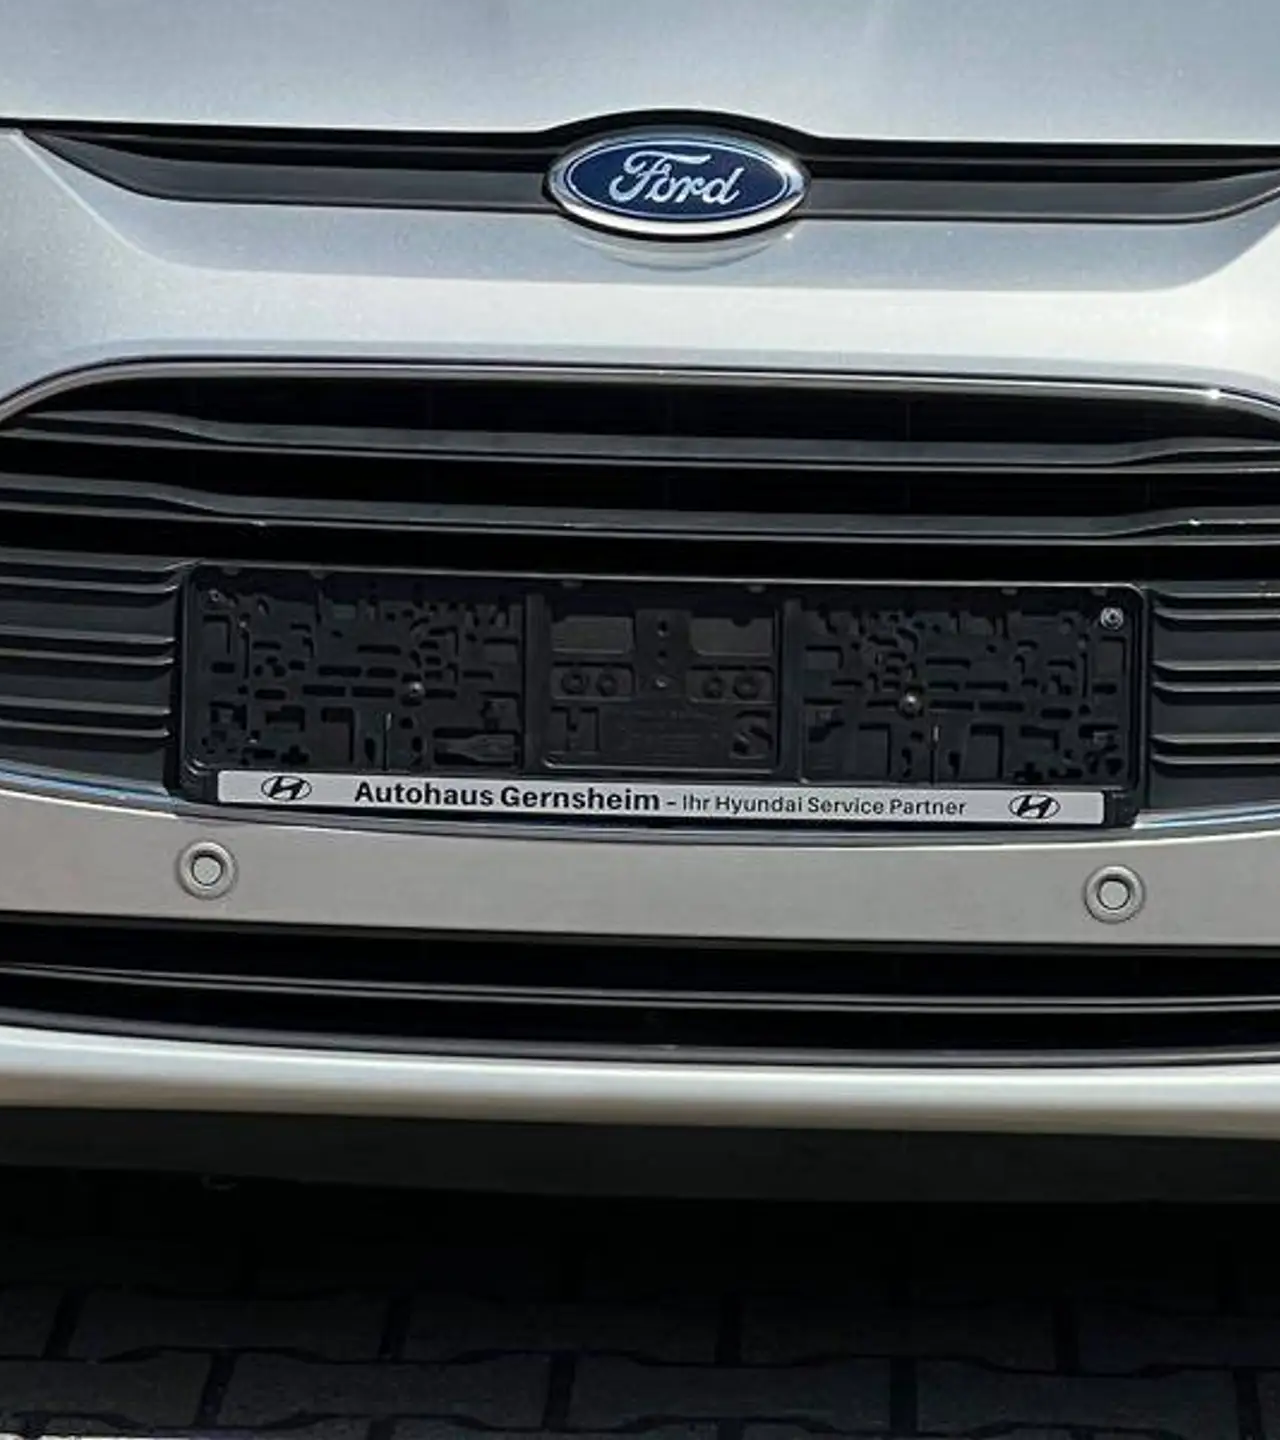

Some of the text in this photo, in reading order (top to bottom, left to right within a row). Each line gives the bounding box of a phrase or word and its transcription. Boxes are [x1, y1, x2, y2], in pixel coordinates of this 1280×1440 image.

[608, 149, 745, 205] Ford
[354, 780, 494, 807] Autohaus
[500, 784, 661, 812] Gernsheim
[681, 794, 711, 813] Ihr
[714, 795, 804, 815] Hyundai
[807, 798, 886, 816] Service
[889, 799, 967, 817] Partner
